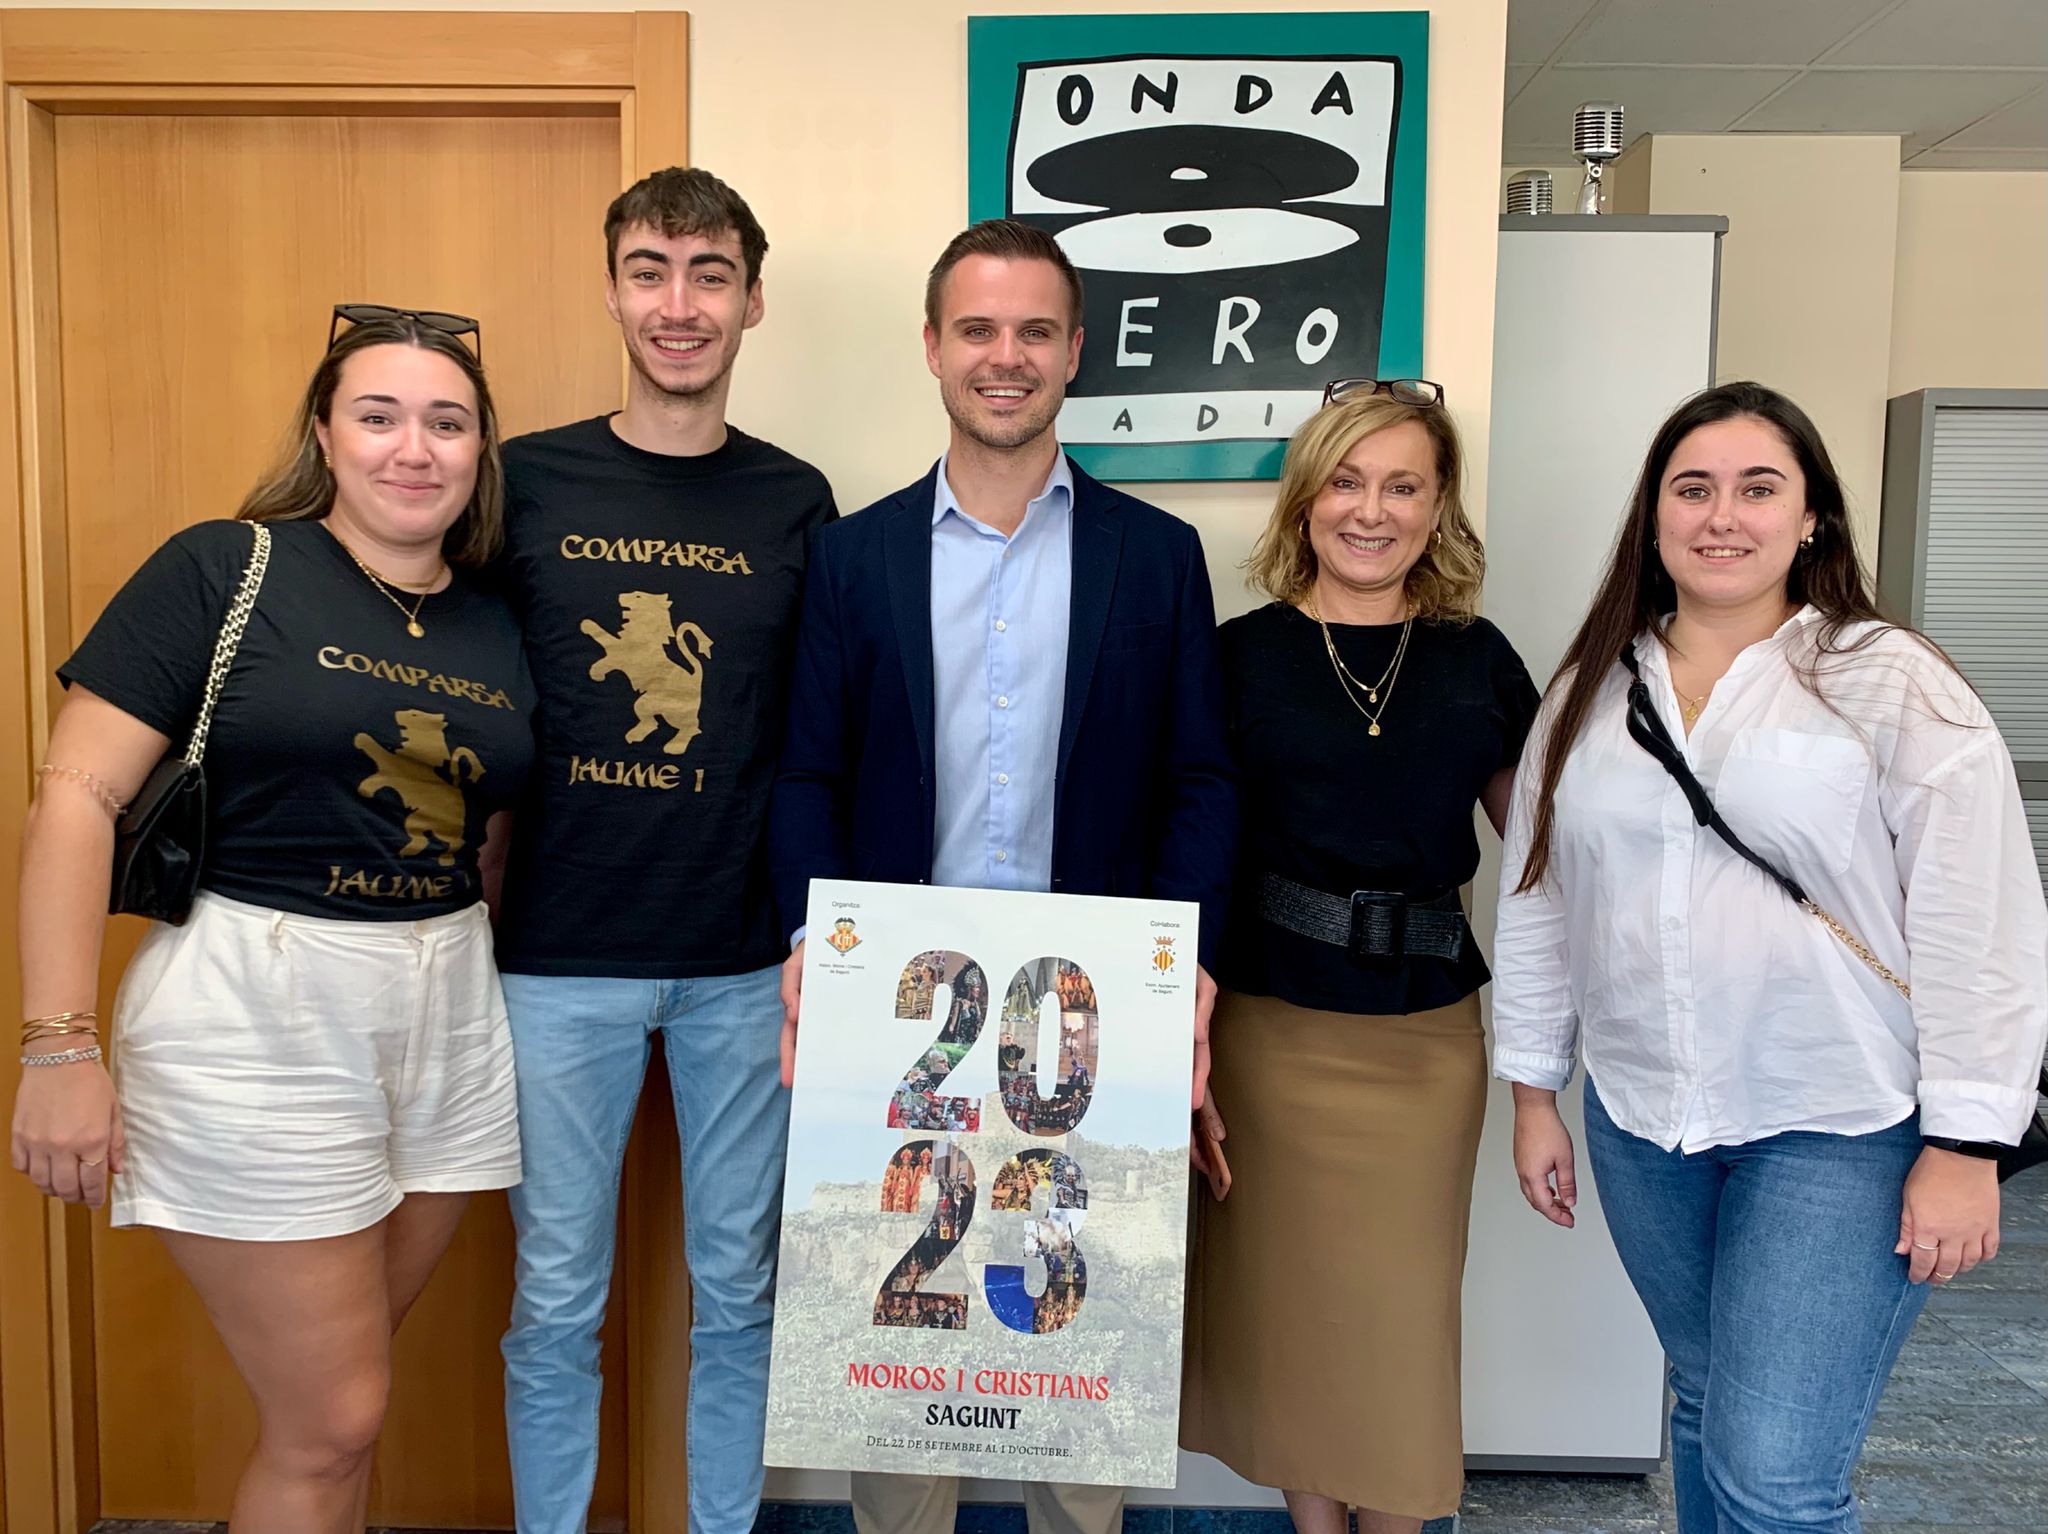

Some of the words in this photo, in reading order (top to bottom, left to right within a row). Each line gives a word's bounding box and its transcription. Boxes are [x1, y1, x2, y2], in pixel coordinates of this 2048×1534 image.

[1056, 70, 1354, 126] ONDA
[1115, 296, 1339, 367] ERO
[1113, 402, 1273, 432] ADI
[560, 534, 754, 575] COMPARSA
[317, 645, 516, 711] COMPARSA
[568, 755, 681, 790] JAUME
[323, 865, 454, 900] JAUME
[847, 1362, 947, 1392] MOROS
[956, 1369, 966, 1393] I
[974, 1369, 1110, 1401] CRISTIANS
[925, 1403, 1022, 1431] SAGUNT
[891, 1439, 904, 1449] 22
[907, 1439, 922, 1450] DE
[924, 1440, 983, 1453] SETEMBRE
[984, 1443, 998, 1453] AL
